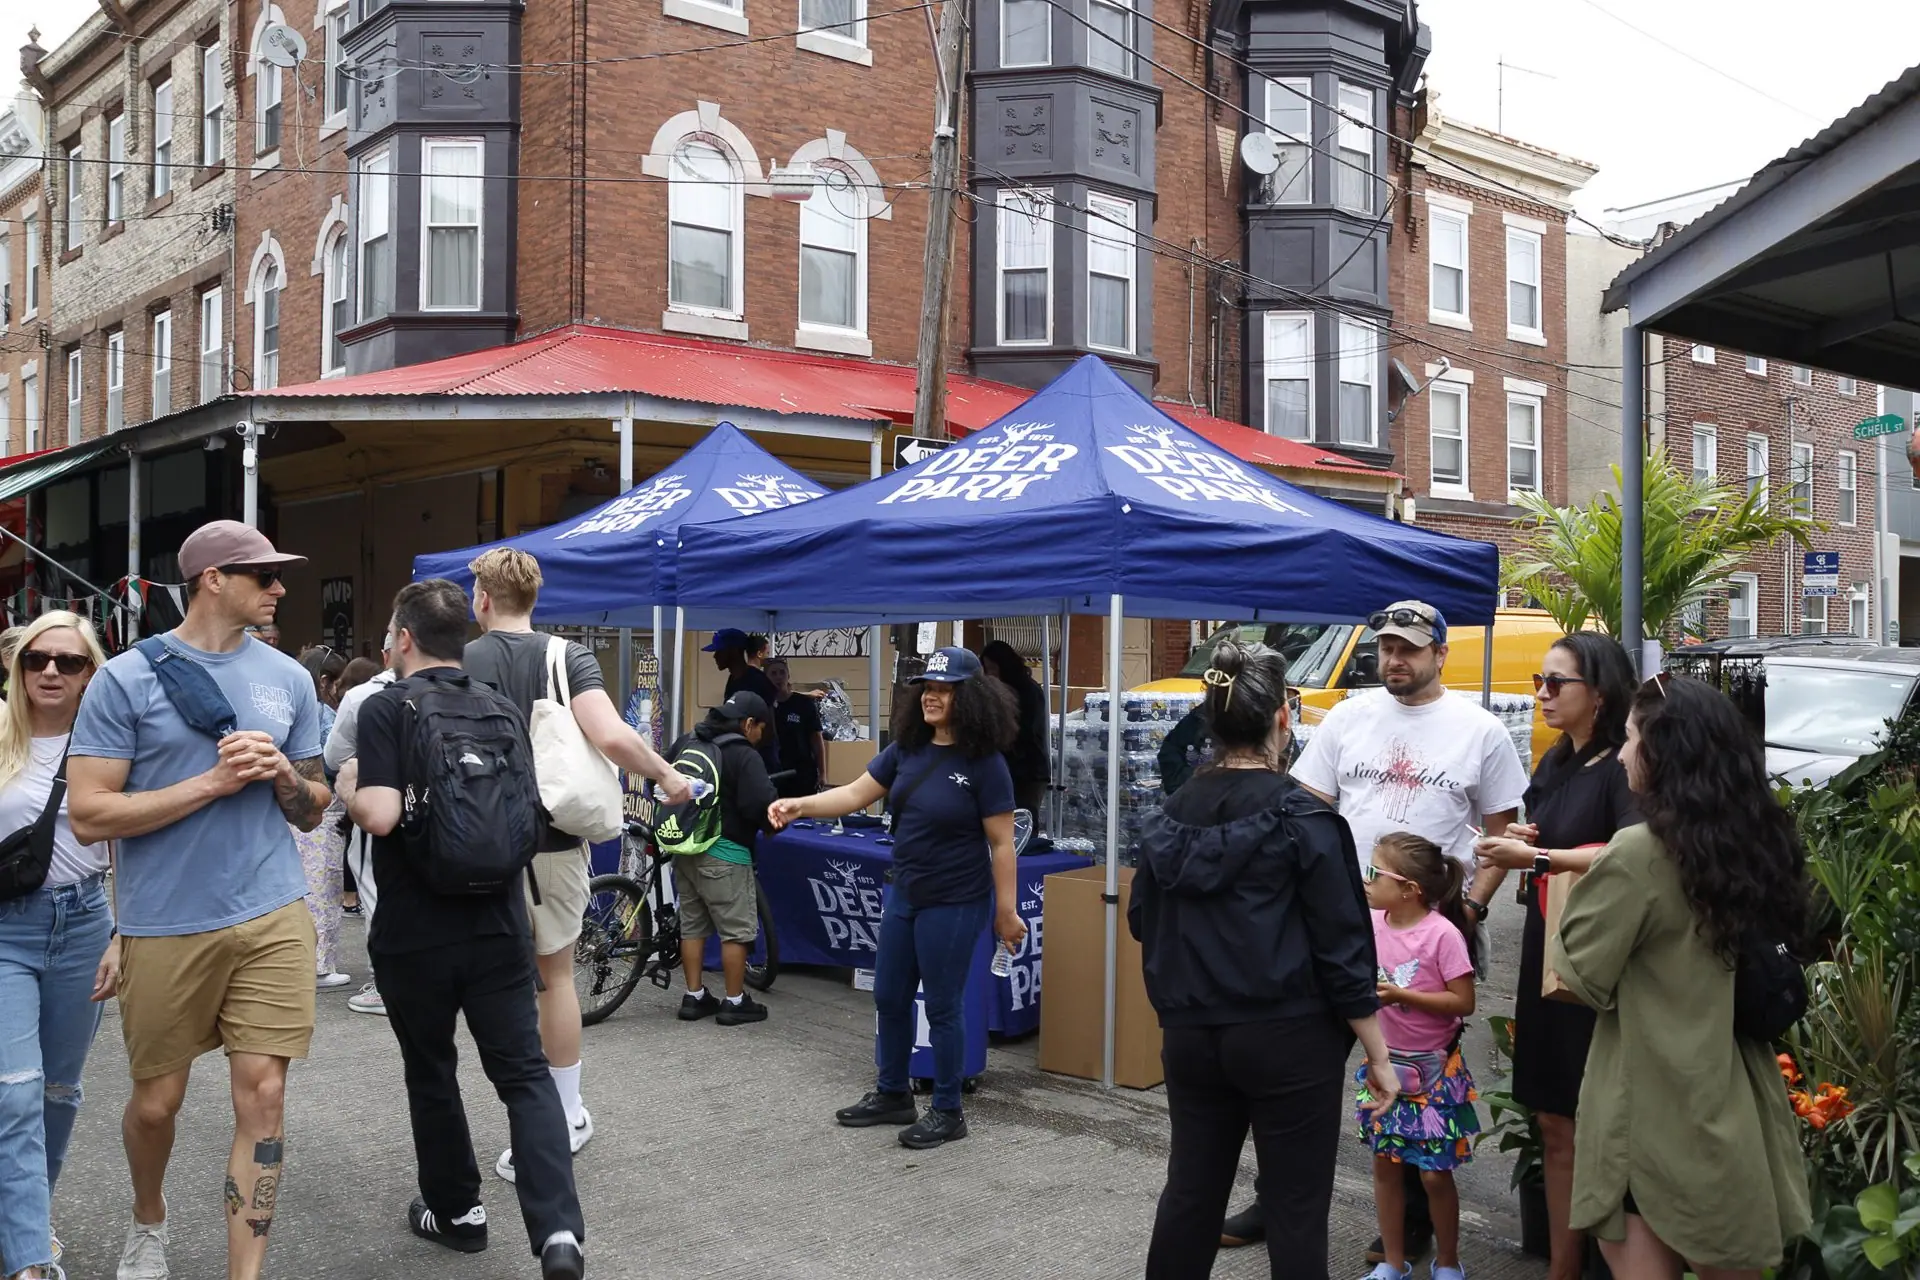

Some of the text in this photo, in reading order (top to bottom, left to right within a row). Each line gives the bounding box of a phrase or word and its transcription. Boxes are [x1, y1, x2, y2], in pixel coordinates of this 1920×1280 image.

[1854, 422, 1903, 438] SCHELL ST
[914, 443, 1079, 477] DEER
[1104, 444, 1263, 487] DEER
[590, 488, 693, 520] DEER
[876, 474, 1052, 504] PARK
[1144, 475, 1313, 517] PARK
[552, 510, 665, 540] PARK
[323, 580, 352, 610] MVP
[638, 659, 658, 674] DEER
[637, 674, 658, 690] PARK
[628, 771, 645, 794] WIN
[823, 871, 875, 885] EST. 1873
[807, 877, 883, 919] DEE
[1021, 900, 1038, 911] EST.
[821, 915, 881, 951] PA
